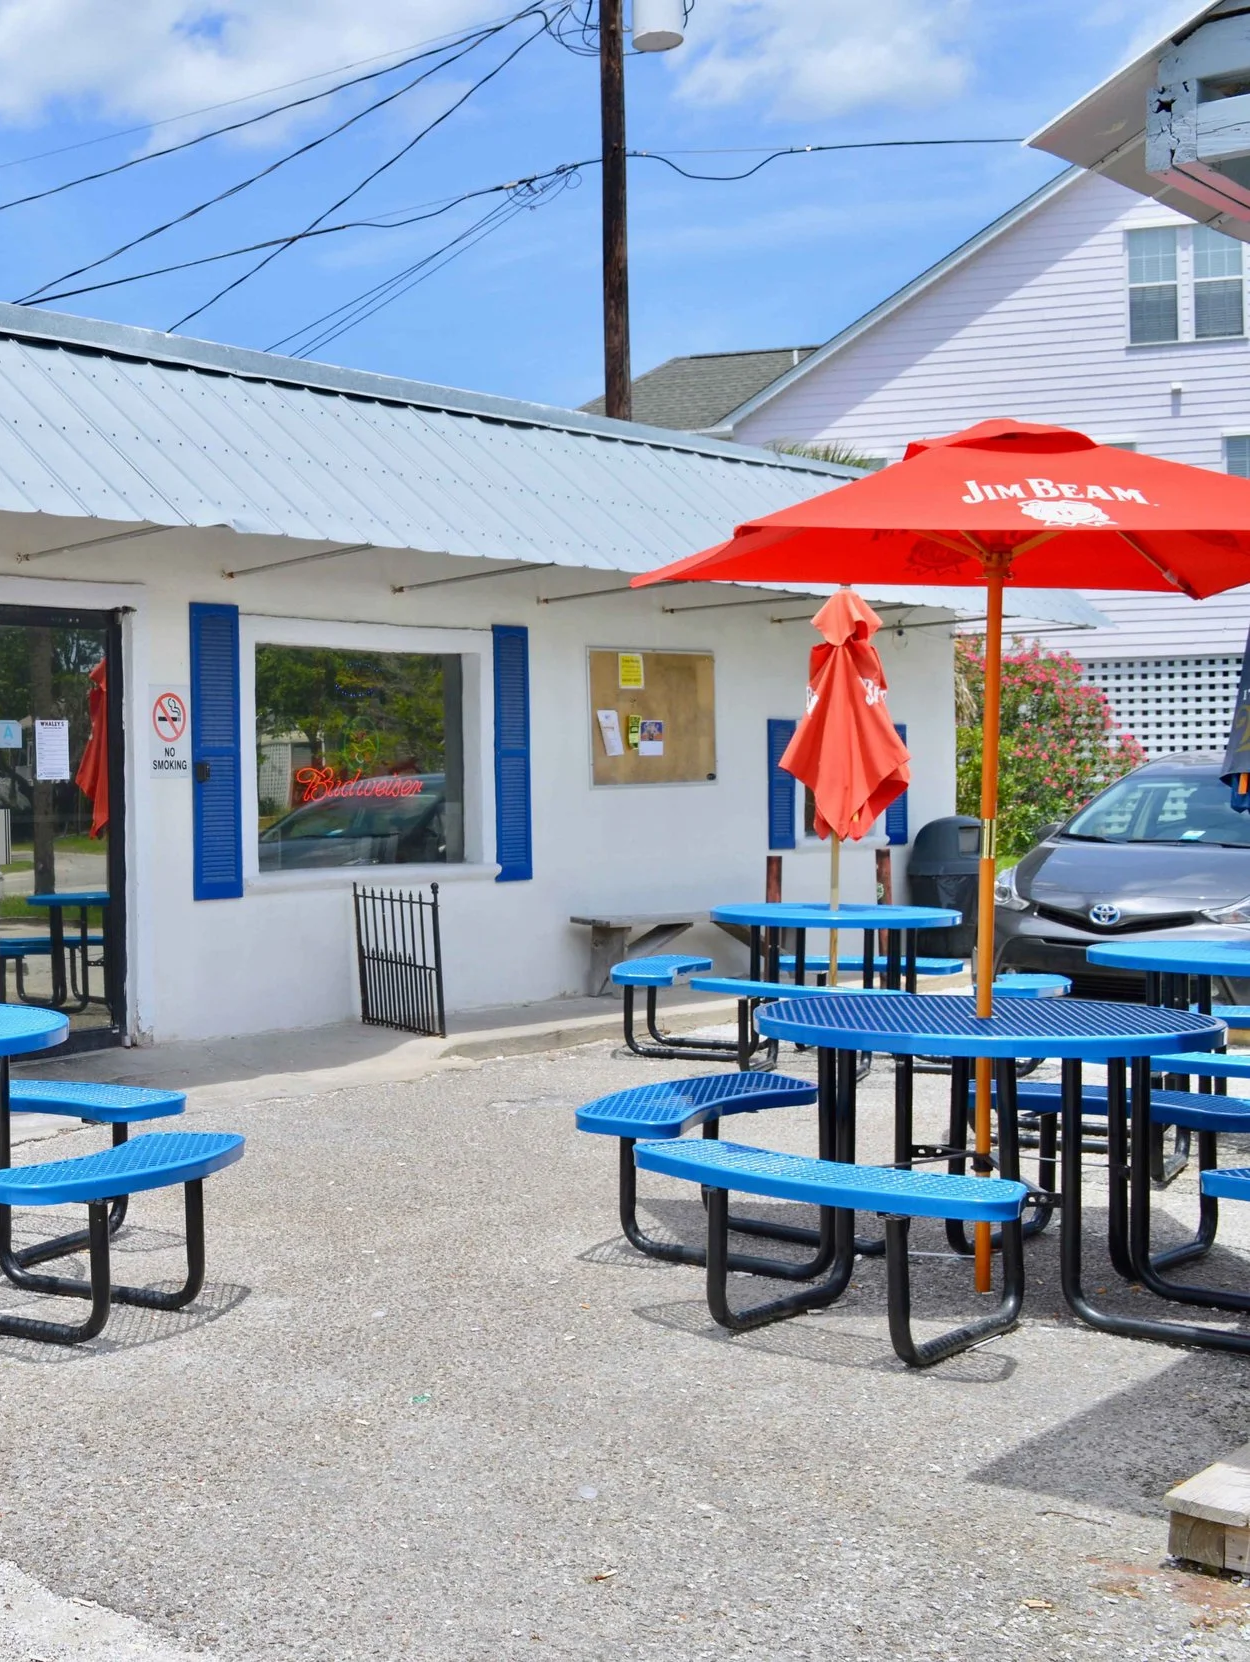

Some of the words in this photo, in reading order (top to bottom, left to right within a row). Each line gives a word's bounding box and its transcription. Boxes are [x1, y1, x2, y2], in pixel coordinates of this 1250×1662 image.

[961, 480, 1027, 504] JIM
[1025, 478, 1150, 505] BEAM
[164, 747, 176, 757] NO
[152, 760, 188, 770] SMOKING
[296, 766, 424, 802] Budweiser
